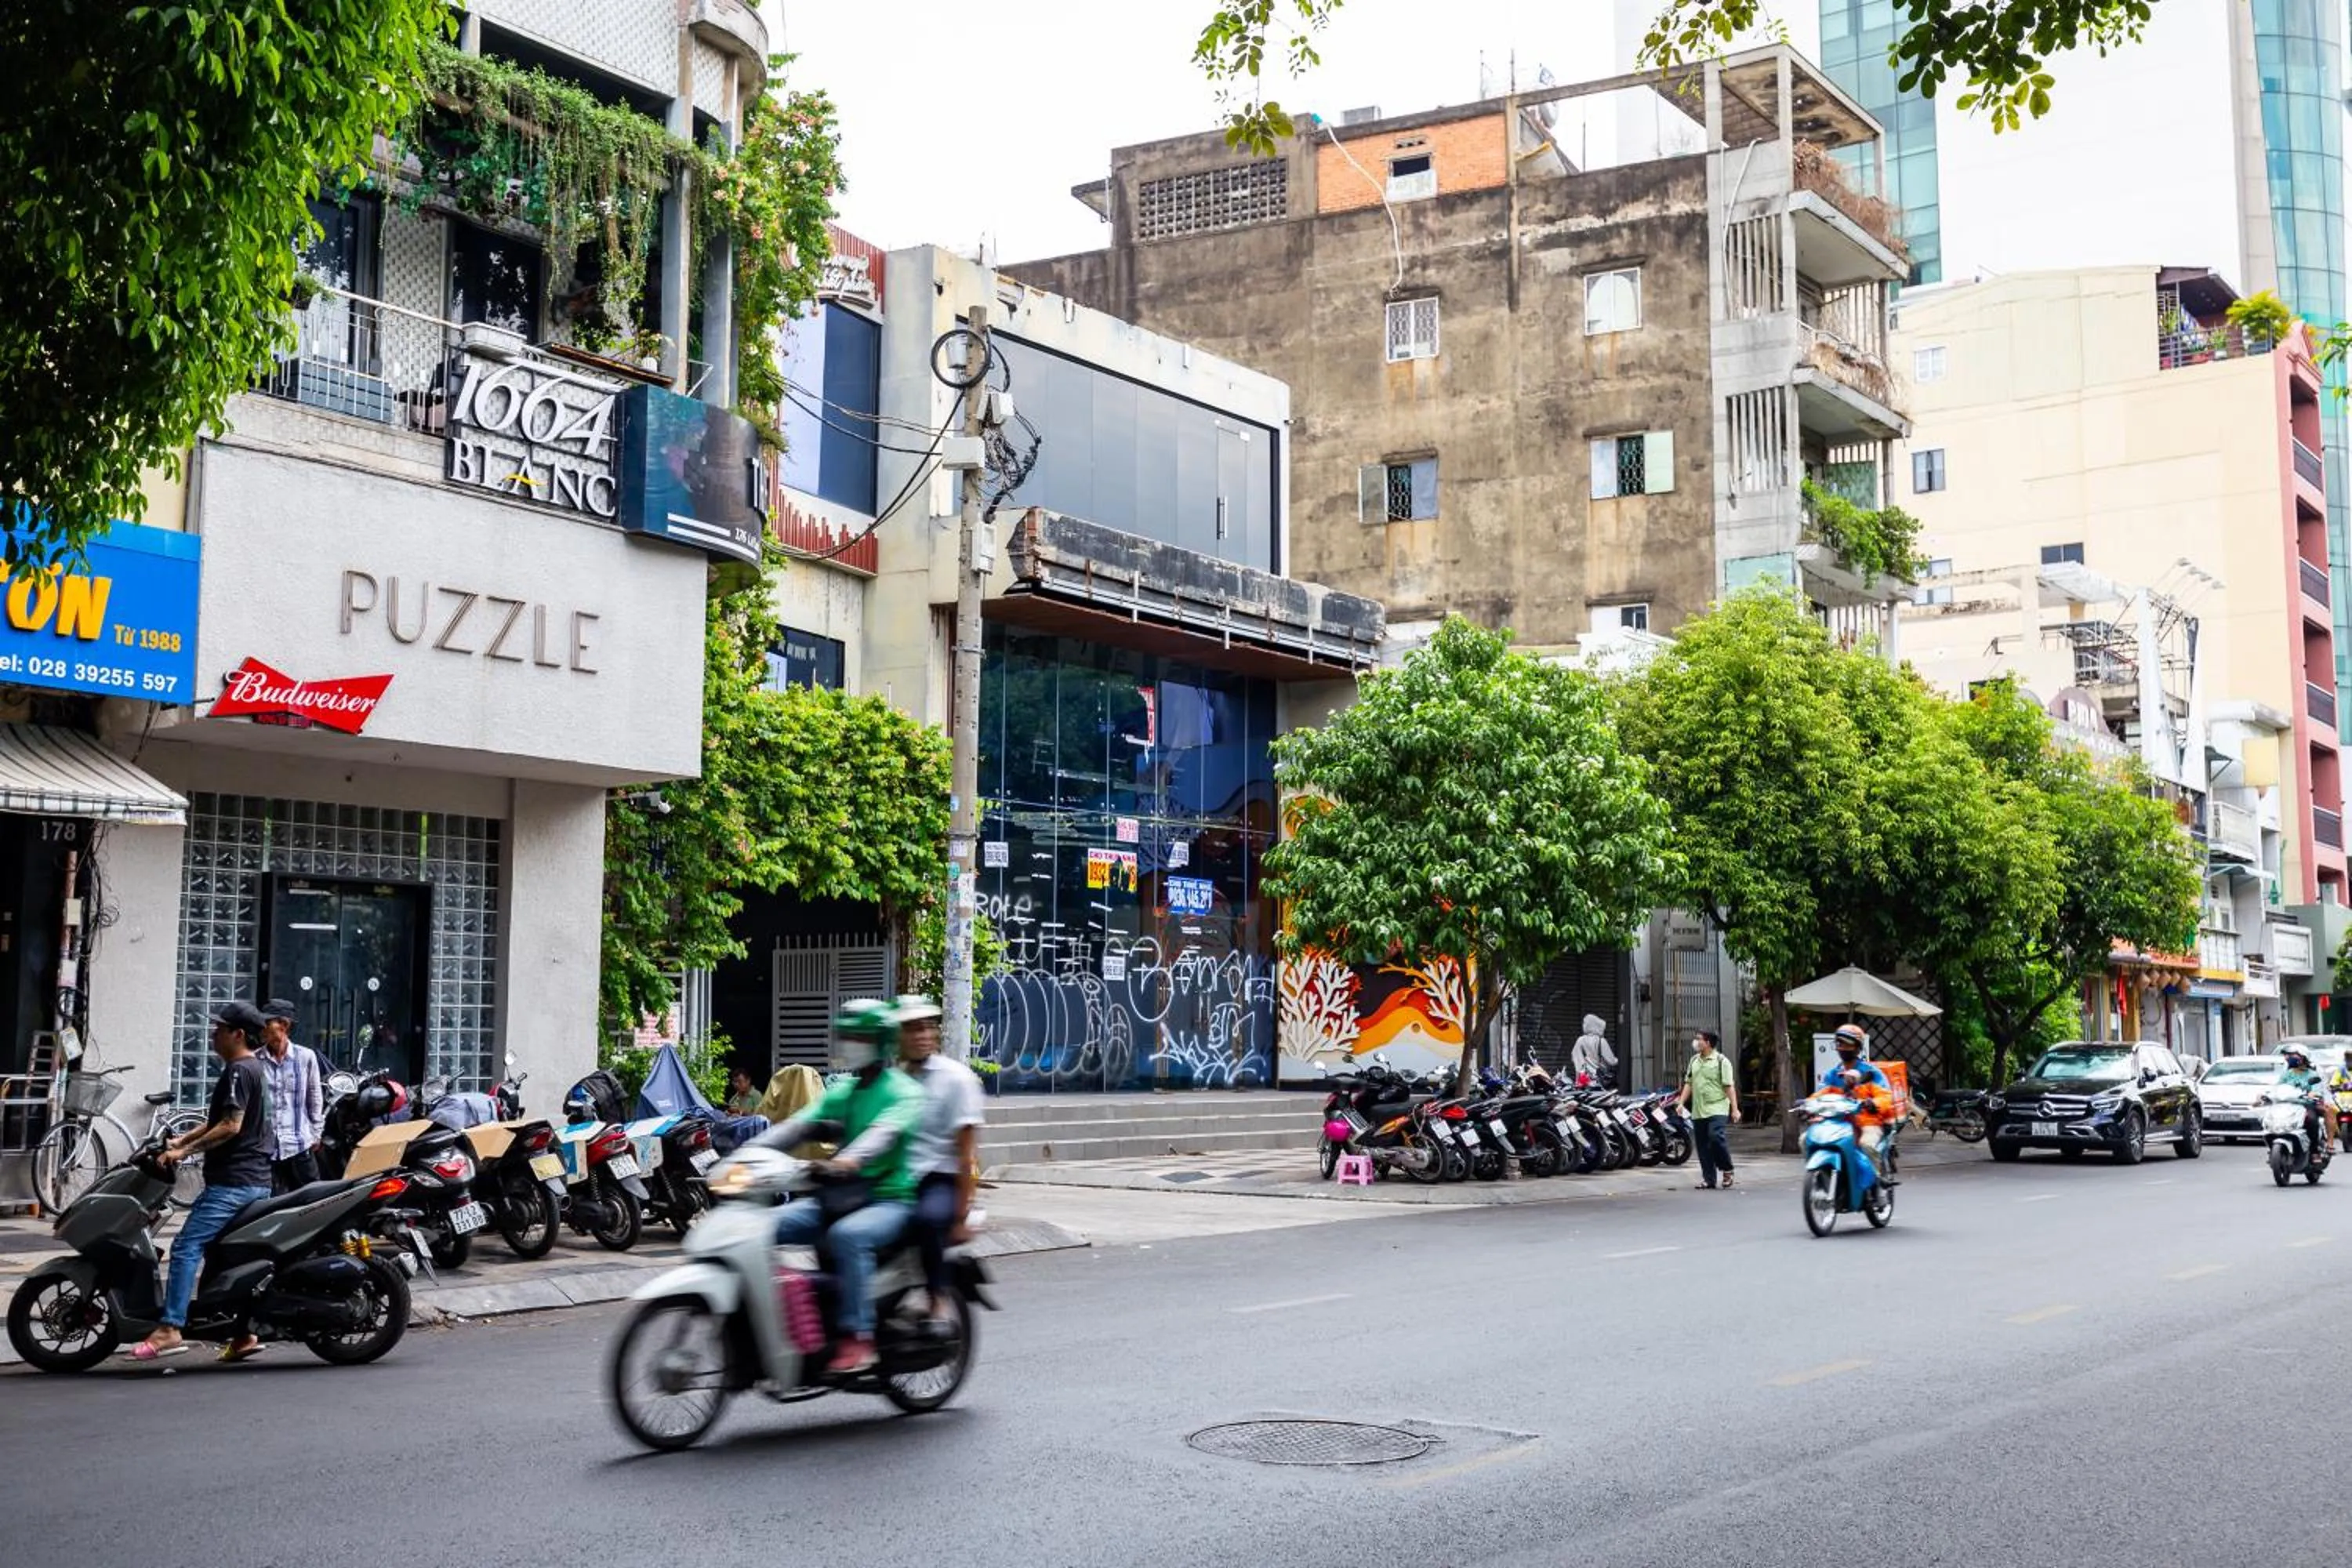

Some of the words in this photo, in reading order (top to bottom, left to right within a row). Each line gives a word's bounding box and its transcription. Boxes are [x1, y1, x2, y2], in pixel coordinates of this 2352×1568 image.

[453, 364, 618, 456] 1664
[451, 437, 615, 517] BLANC
[140, 629, 182, 652] 1988
[339, 569, 601, 675] PUZZLE
[28, 656, 67, 677] 028
[74, 662, 135, 687] 39255
[142, 672, 177, 693] 597
[226, 670, 376, 713] Budweiser
[42, 820, 76, 842] 178
